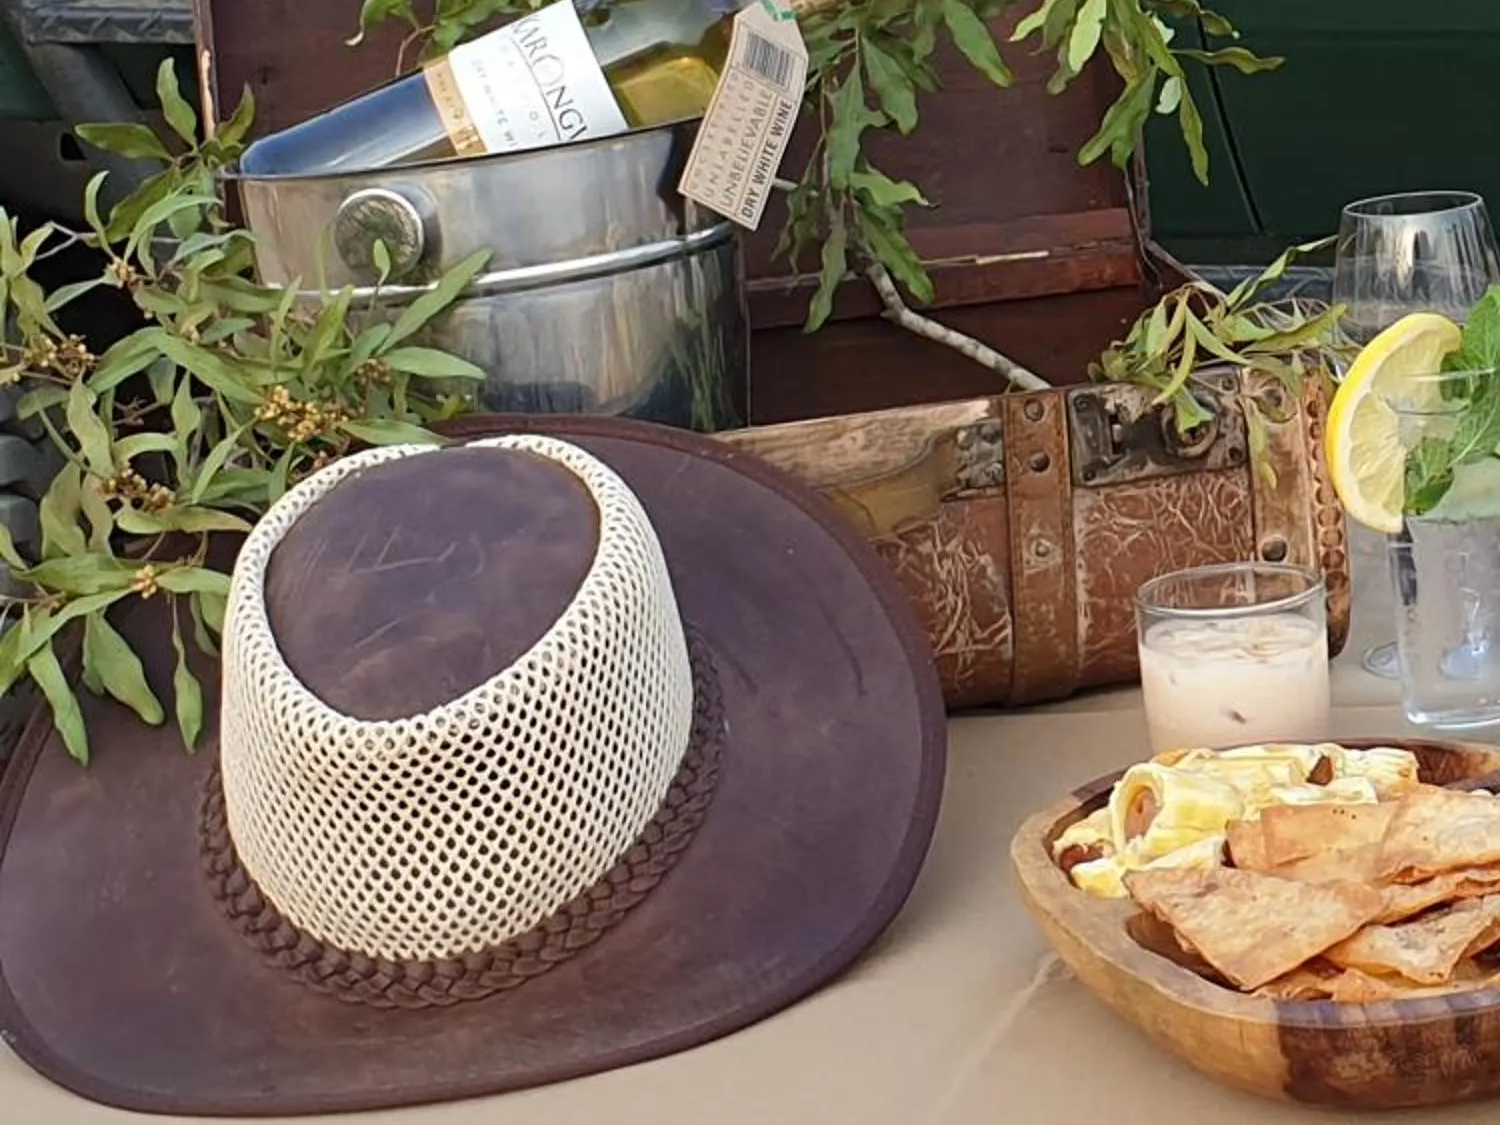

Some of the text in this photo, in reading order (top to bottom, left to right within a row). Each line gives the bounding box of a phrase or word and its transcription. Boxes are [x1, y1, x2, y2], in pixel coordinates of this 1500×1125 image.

[719, 88, 773, 209] UNBELIEVABLE
[740, 98, 793, 219] DRY WHITE WINE
